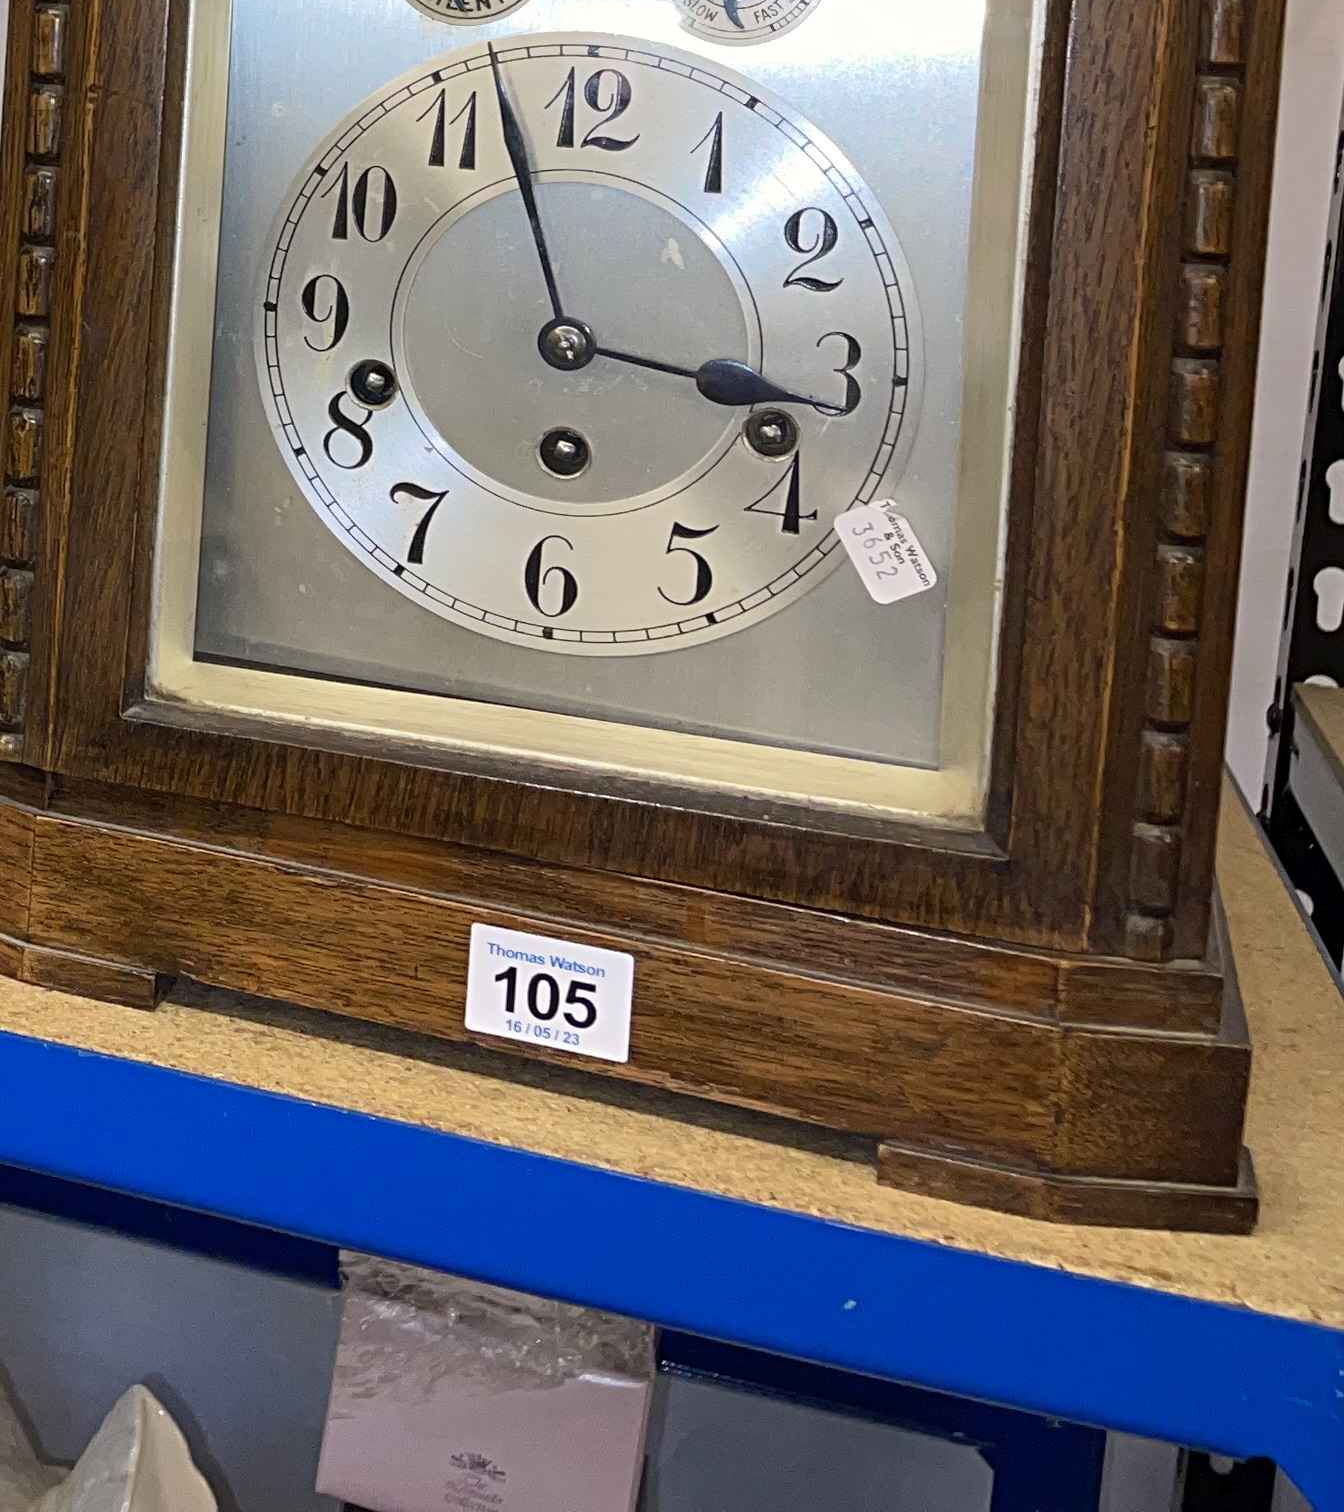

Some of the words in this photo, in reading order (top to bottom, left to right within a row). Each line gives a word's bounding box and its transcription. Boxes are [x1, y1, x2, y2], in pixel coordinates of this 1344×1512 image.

[753, 0, 785, 24] FAST
[415, 87, 477, 171] 11
[544, 65, 641, 152] 12
[690, 110, 723, 194] 1
[320, 160, 398, 243] 10
[782, 206, 845, 293] 2
[300, 274, 350, 353] 9
[814, 331, 862, 417] 3
[322, 390, 374, 470] 8
[389, 481, 450, 566] 7
[743, 449, 818, 535] 4
[524, 534, 579, 618] 6
[657, 521, 720, 606] 5
[852, 522, 899, 581] 3652
[889, 542, 906, 565] Son
[905, 544, 931, 587] Watson
[486, 941, 546, 966] Thomas
[549, 954, 606, 979] Watson
[494, 965, 598, 1029] 105
